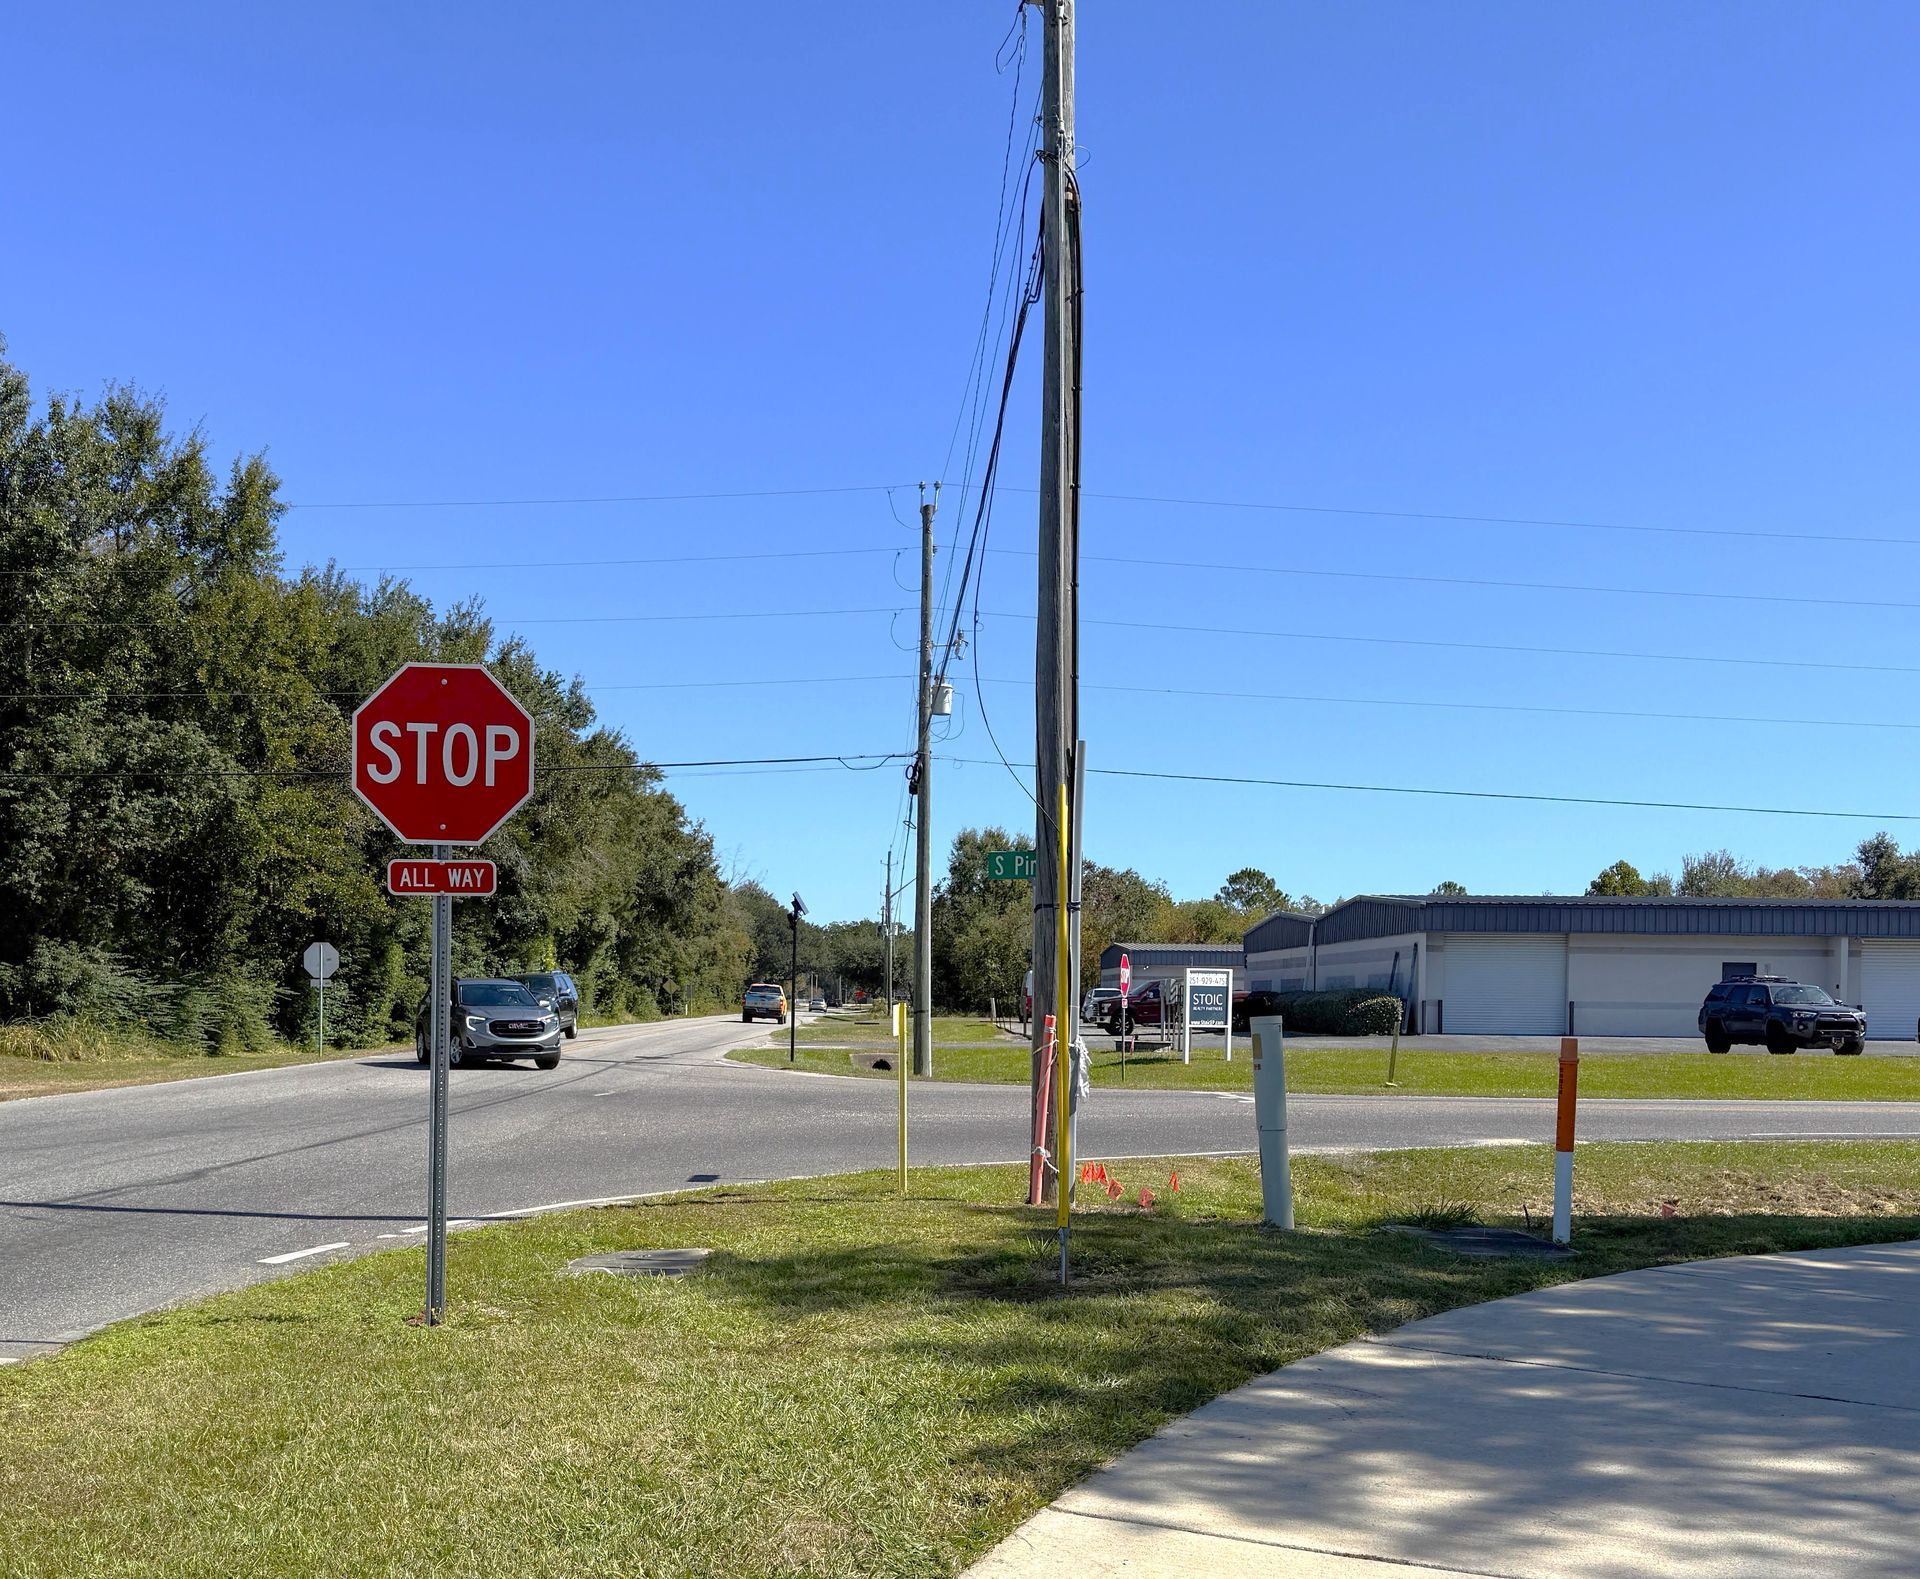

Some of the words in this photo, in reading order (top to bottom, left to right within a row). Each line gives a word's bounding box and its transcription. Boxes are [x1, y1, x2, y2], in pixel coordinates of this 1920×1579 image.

[366, 720, 520, 787] STOP
[995, 856, 1004, 876] S
[400, 867, 435, 887] ALL
[448, 868, 485, 888] WAY
[1193, 994, 1223, 1006] STOIC
